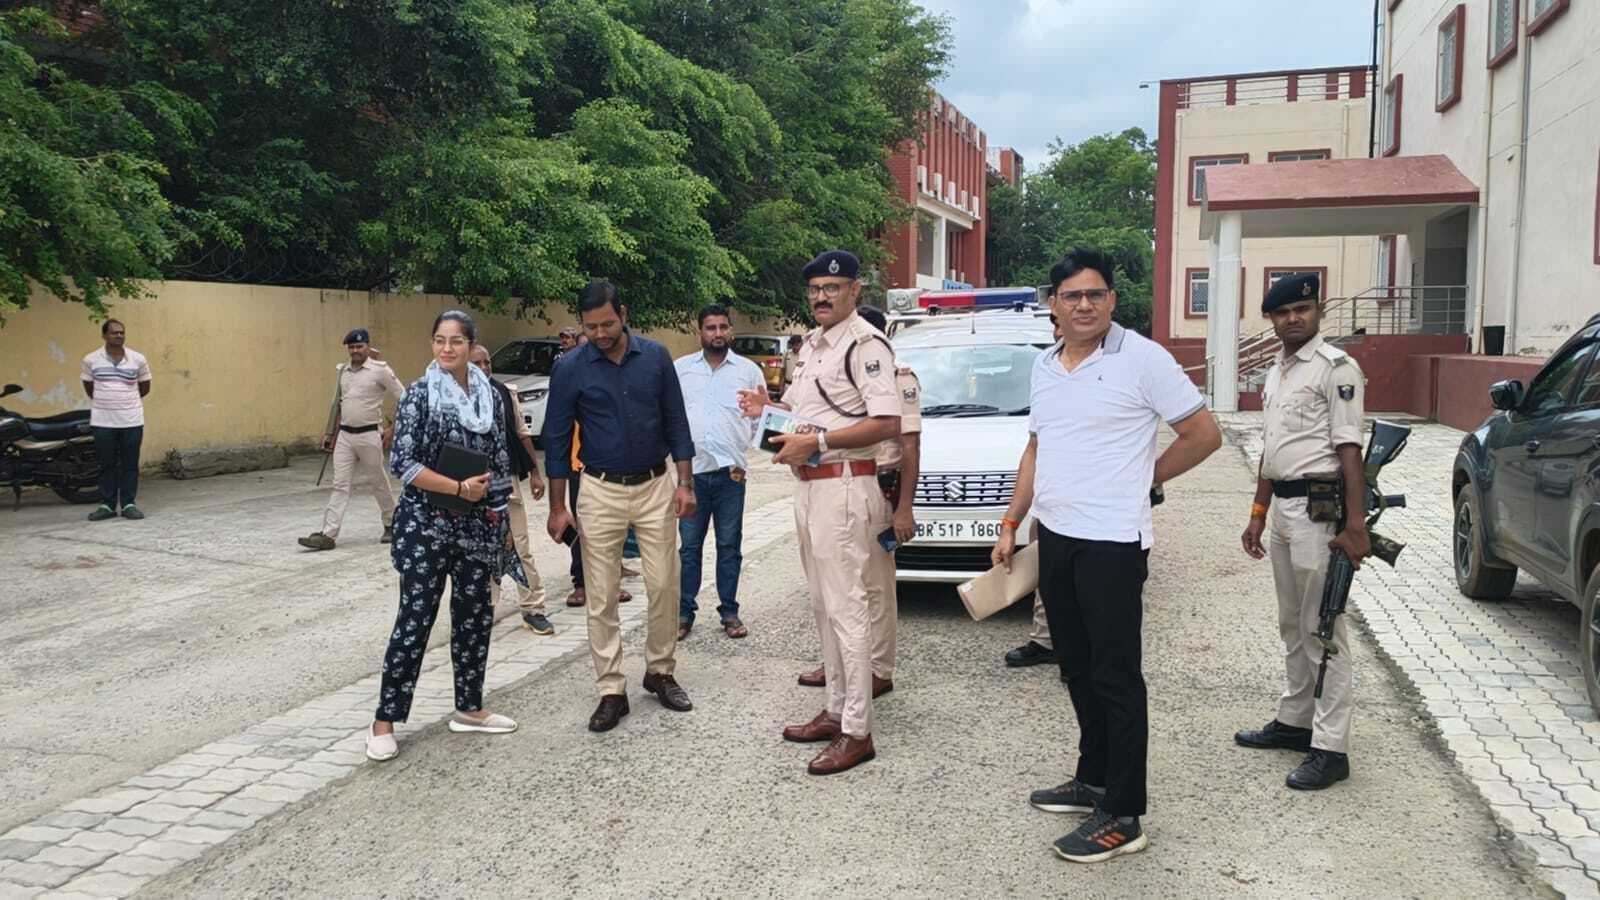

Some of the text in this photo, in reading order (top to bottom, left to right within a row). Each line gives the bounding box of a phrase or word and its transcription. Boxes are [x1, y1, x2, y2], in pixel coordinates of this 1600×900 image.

[917, 523, 1003, 537] BR 51P 1860
